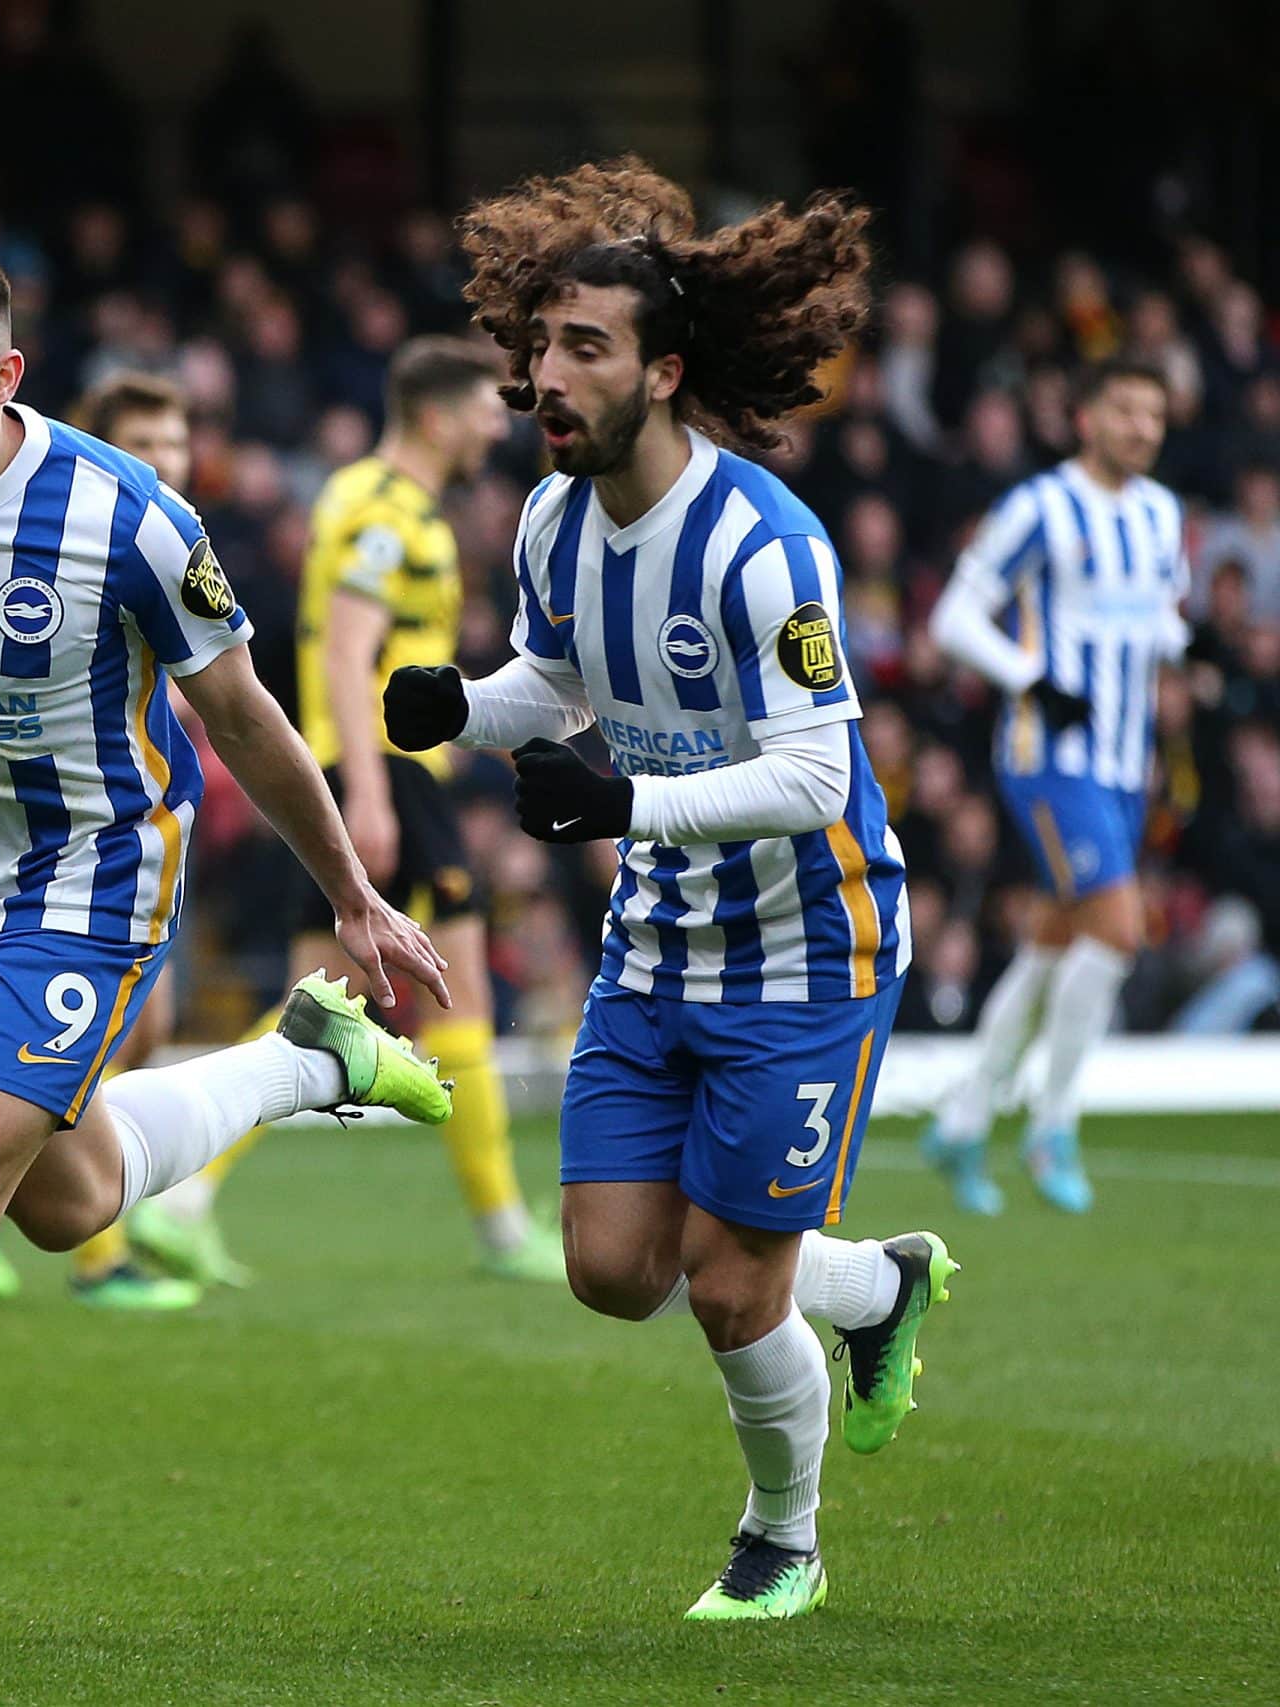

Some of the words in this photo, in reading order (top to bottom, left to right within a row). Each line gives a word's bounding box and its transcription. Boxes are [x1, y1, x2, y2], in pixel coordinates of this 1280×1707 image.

[14, 633, 40, 641] ALBION
[42, 972, 98, 1053] 9
[785, 1082, 837, 1168] 3
